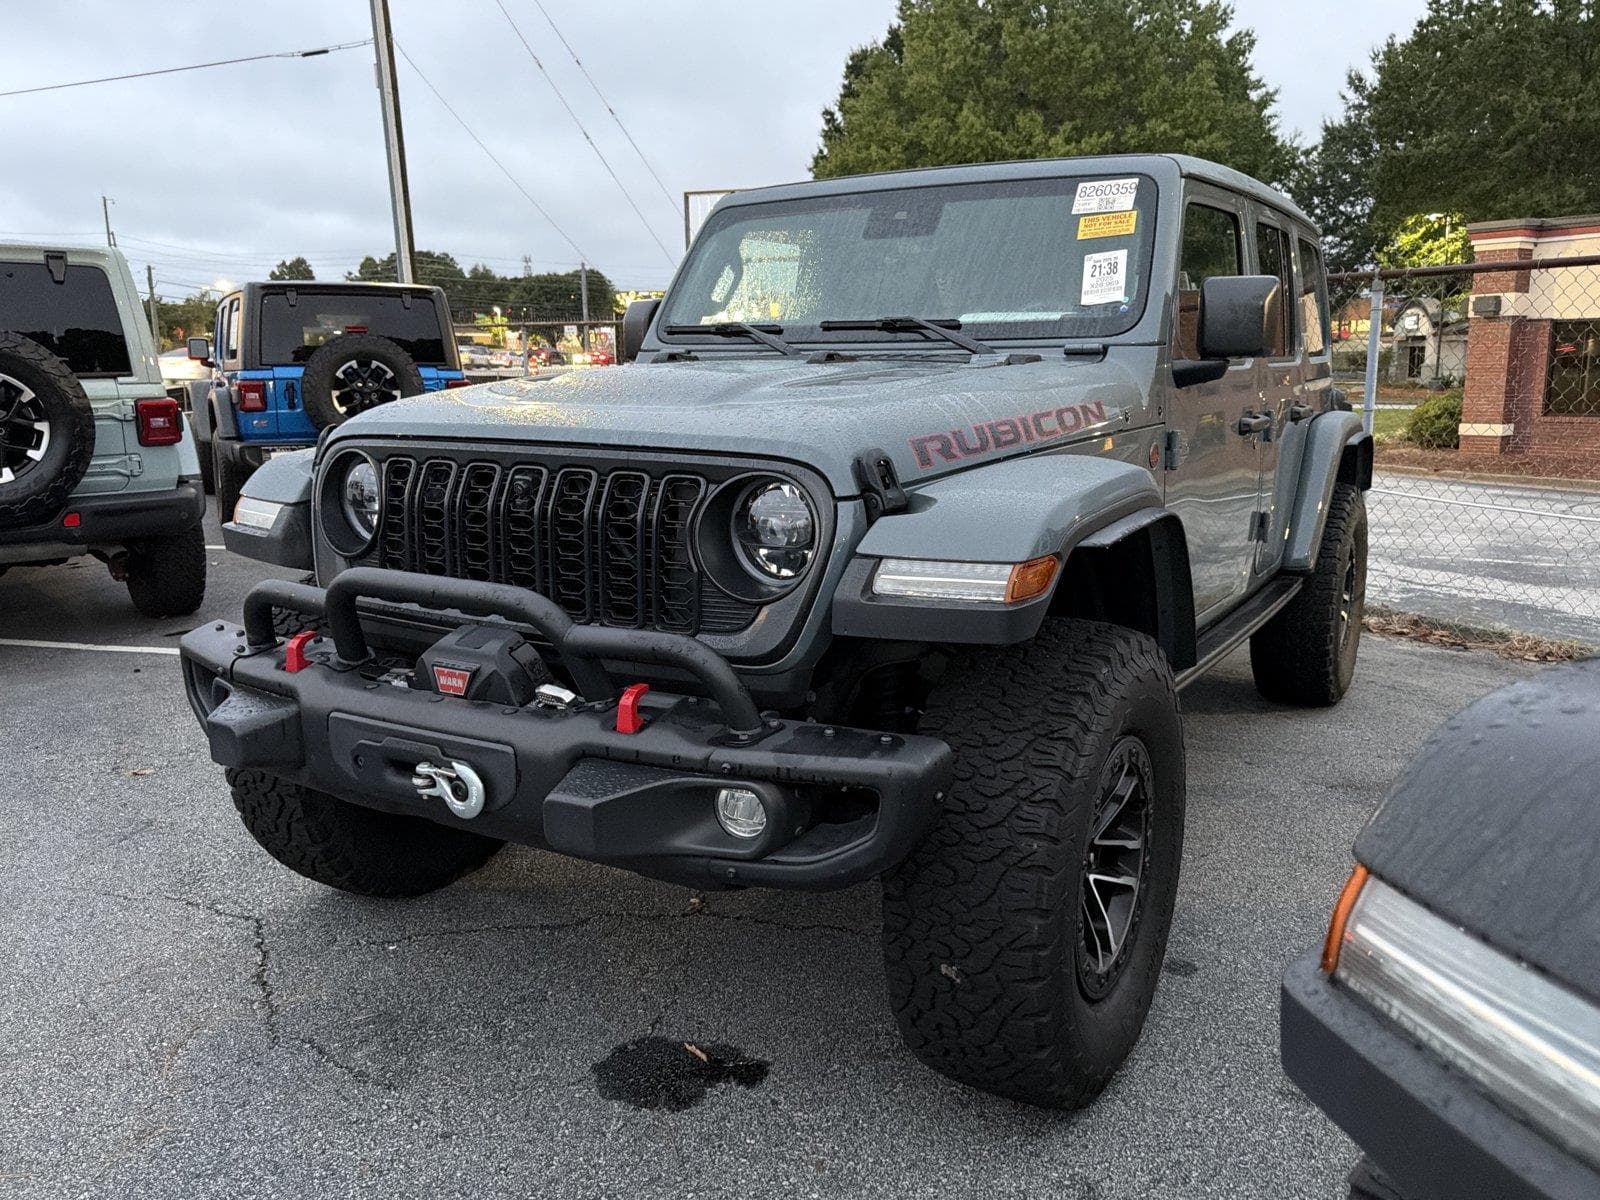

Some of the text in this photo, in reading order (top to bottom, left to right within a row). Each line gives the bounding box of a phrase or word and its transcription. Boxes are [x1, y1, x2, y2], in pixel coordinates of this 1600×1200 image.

[1079, 182, 1138, 198] 8260359
[1102, 213, 1134, 221] VEHICLE
[1090, 261, 1118, 278] 21:38
[908, 400, 1108, 469] RUBICON
[440, 676, 463, 688] WARN
